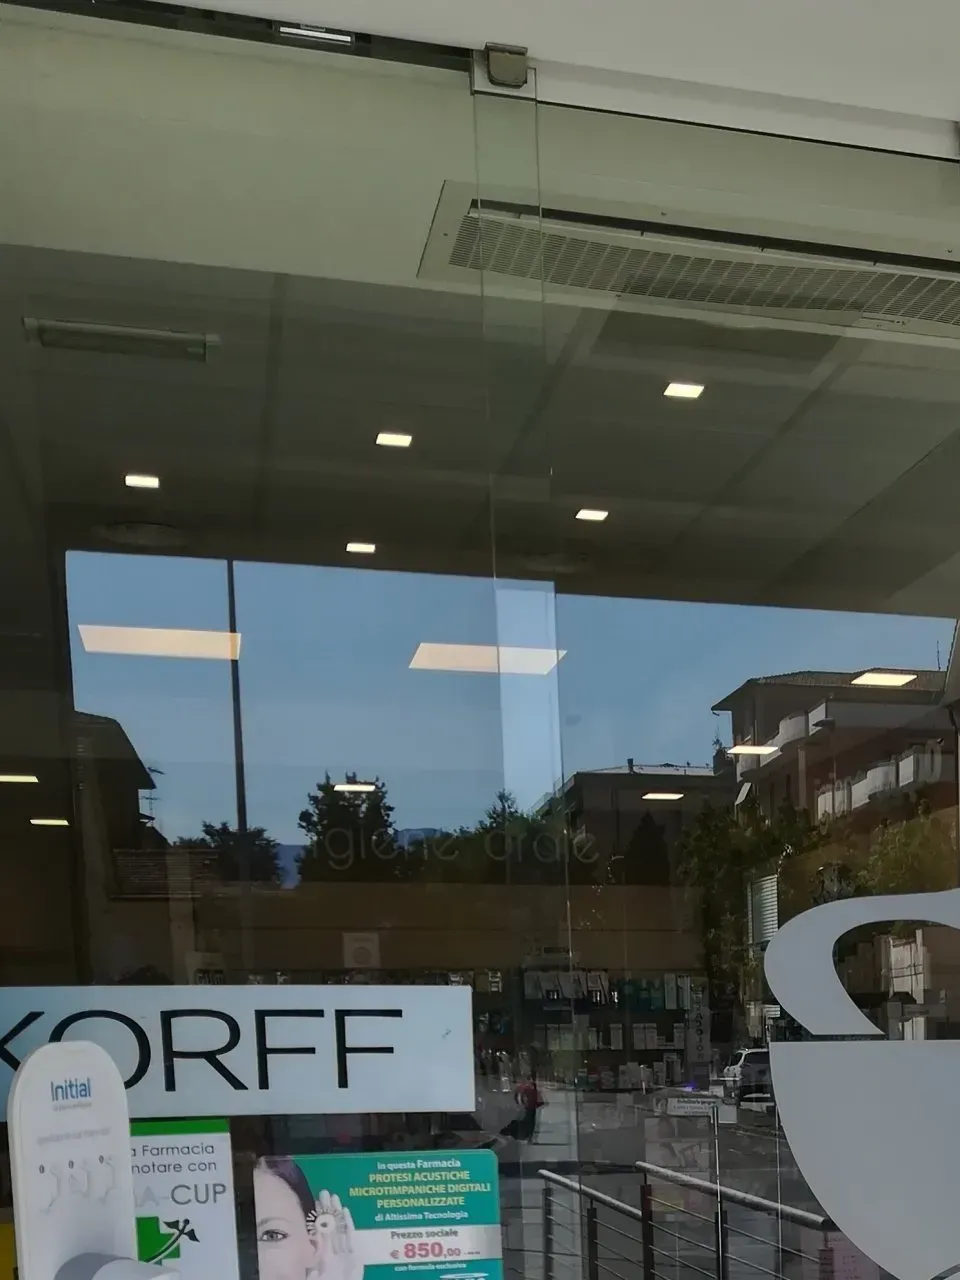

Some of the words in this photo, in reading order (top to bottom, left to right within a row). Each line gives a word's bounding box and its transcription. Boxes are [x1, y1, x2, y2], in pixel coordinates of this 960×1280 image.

[51, 1077, 92, 1102] Initial
[142, 1143, 215, 1157] Farmacia
[131, 1160, 183, 1175] notare
[187, 1162, 217, 1173] con
[417, 1158, 461, 1169] Farmacia
[369, 1173, 412, 1183] PROTESI
[413, 1170, 470, 1182] ACUSTICHE
[349, 1184, 446, 1197] MICROTIMPANICHE
[448, 1183, 491, 1193] DIGITALI
[377, 1196, 465, 1209] PERSONALIZZATE
[424, 1210, 469, 1221] Tecnologia
[391, 1230, 424, 1240] Prezzo
[425, 1228, 459, 1239] sociale
